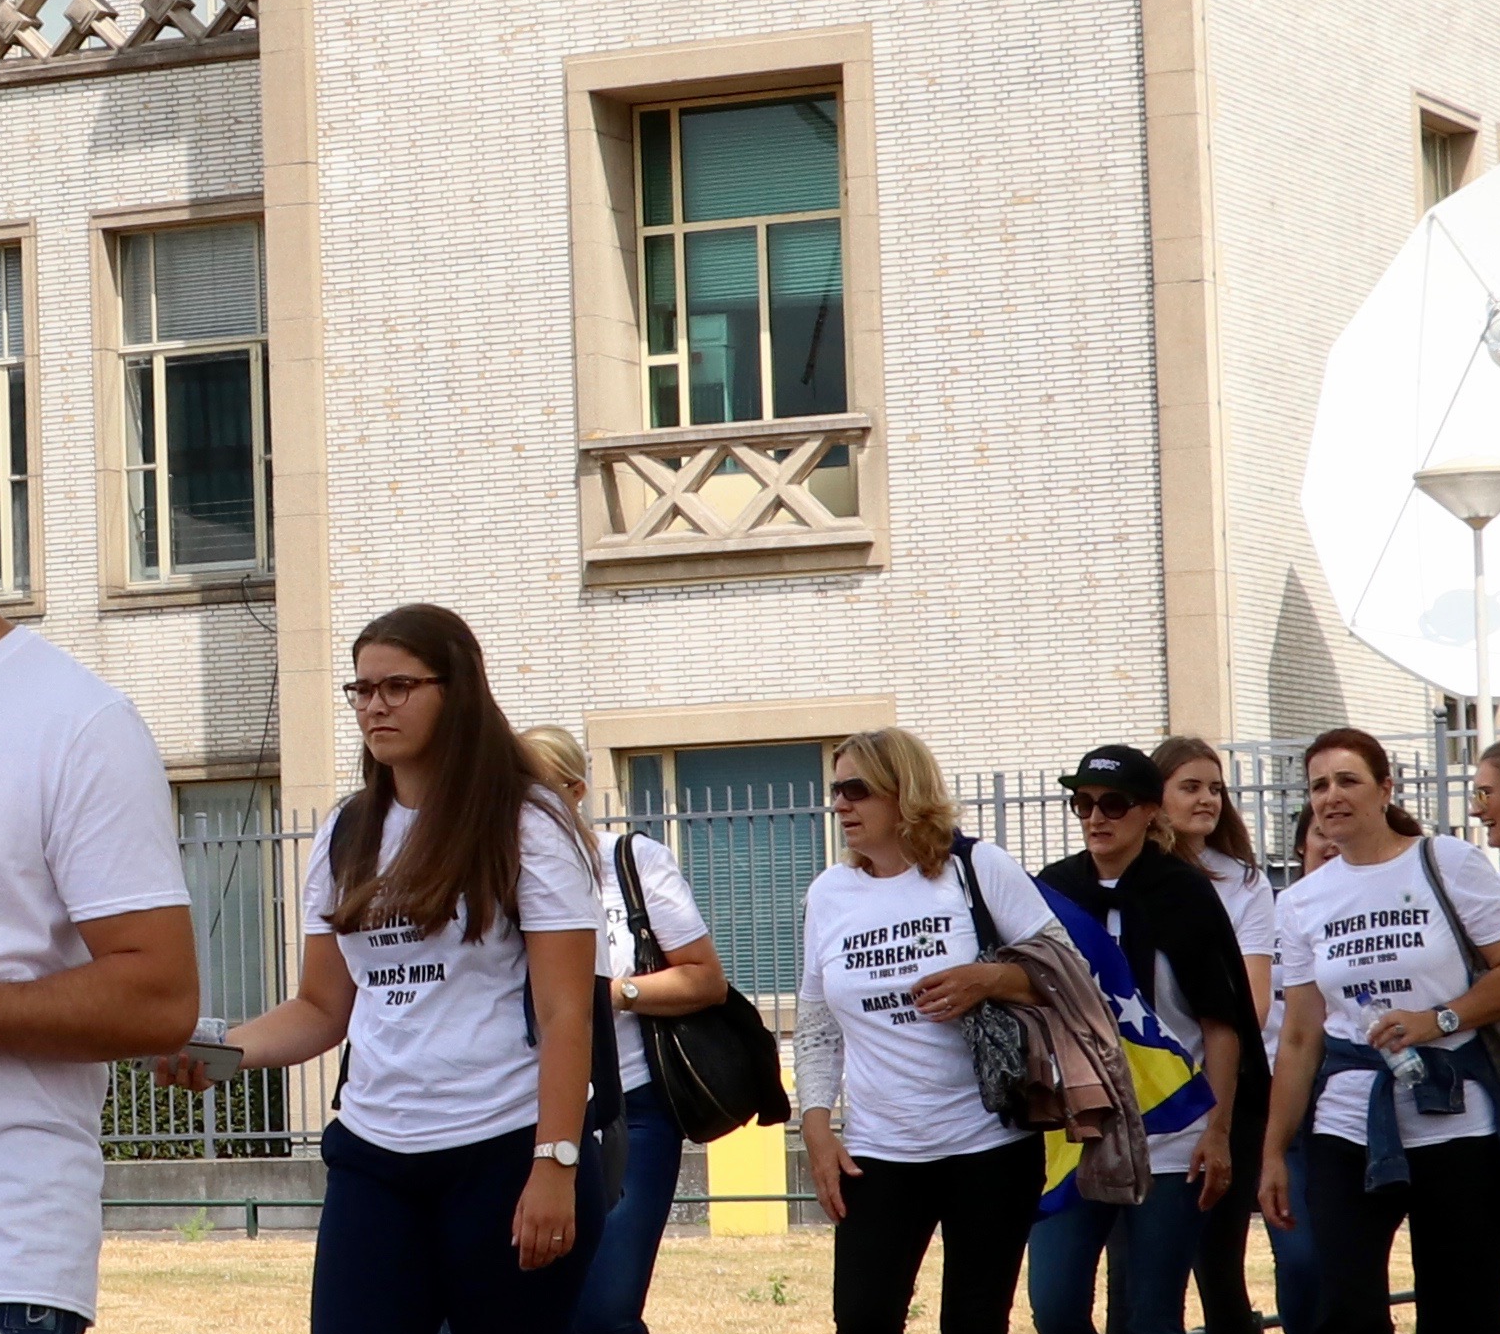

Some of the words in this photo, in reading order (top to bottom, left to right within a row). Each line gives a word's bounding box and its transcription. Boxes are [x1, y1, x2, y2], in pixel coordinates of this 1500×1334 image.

[1324, 914, 1366, 939] NEVER
[1370, 909, 1430, 929] FORGET
[368, 935, 379, 947] 11
[379, 933, 399, 947] JULY
[842, 928, 888, 952] NEVER
[892, 917, 952, 941] FORGET
[1327, 932, 1425, 960] SREBRENICA
[367, 964, 406, 987] MARŠ
[409, 963, 446, 984] MIRA
[1379, 979, 1413, 994] MIRA
[385, 991, 417, 1006] 2018
[861, 992, 899, 1012] MARŠ
[890, 1010, 917, 1025] 2018
